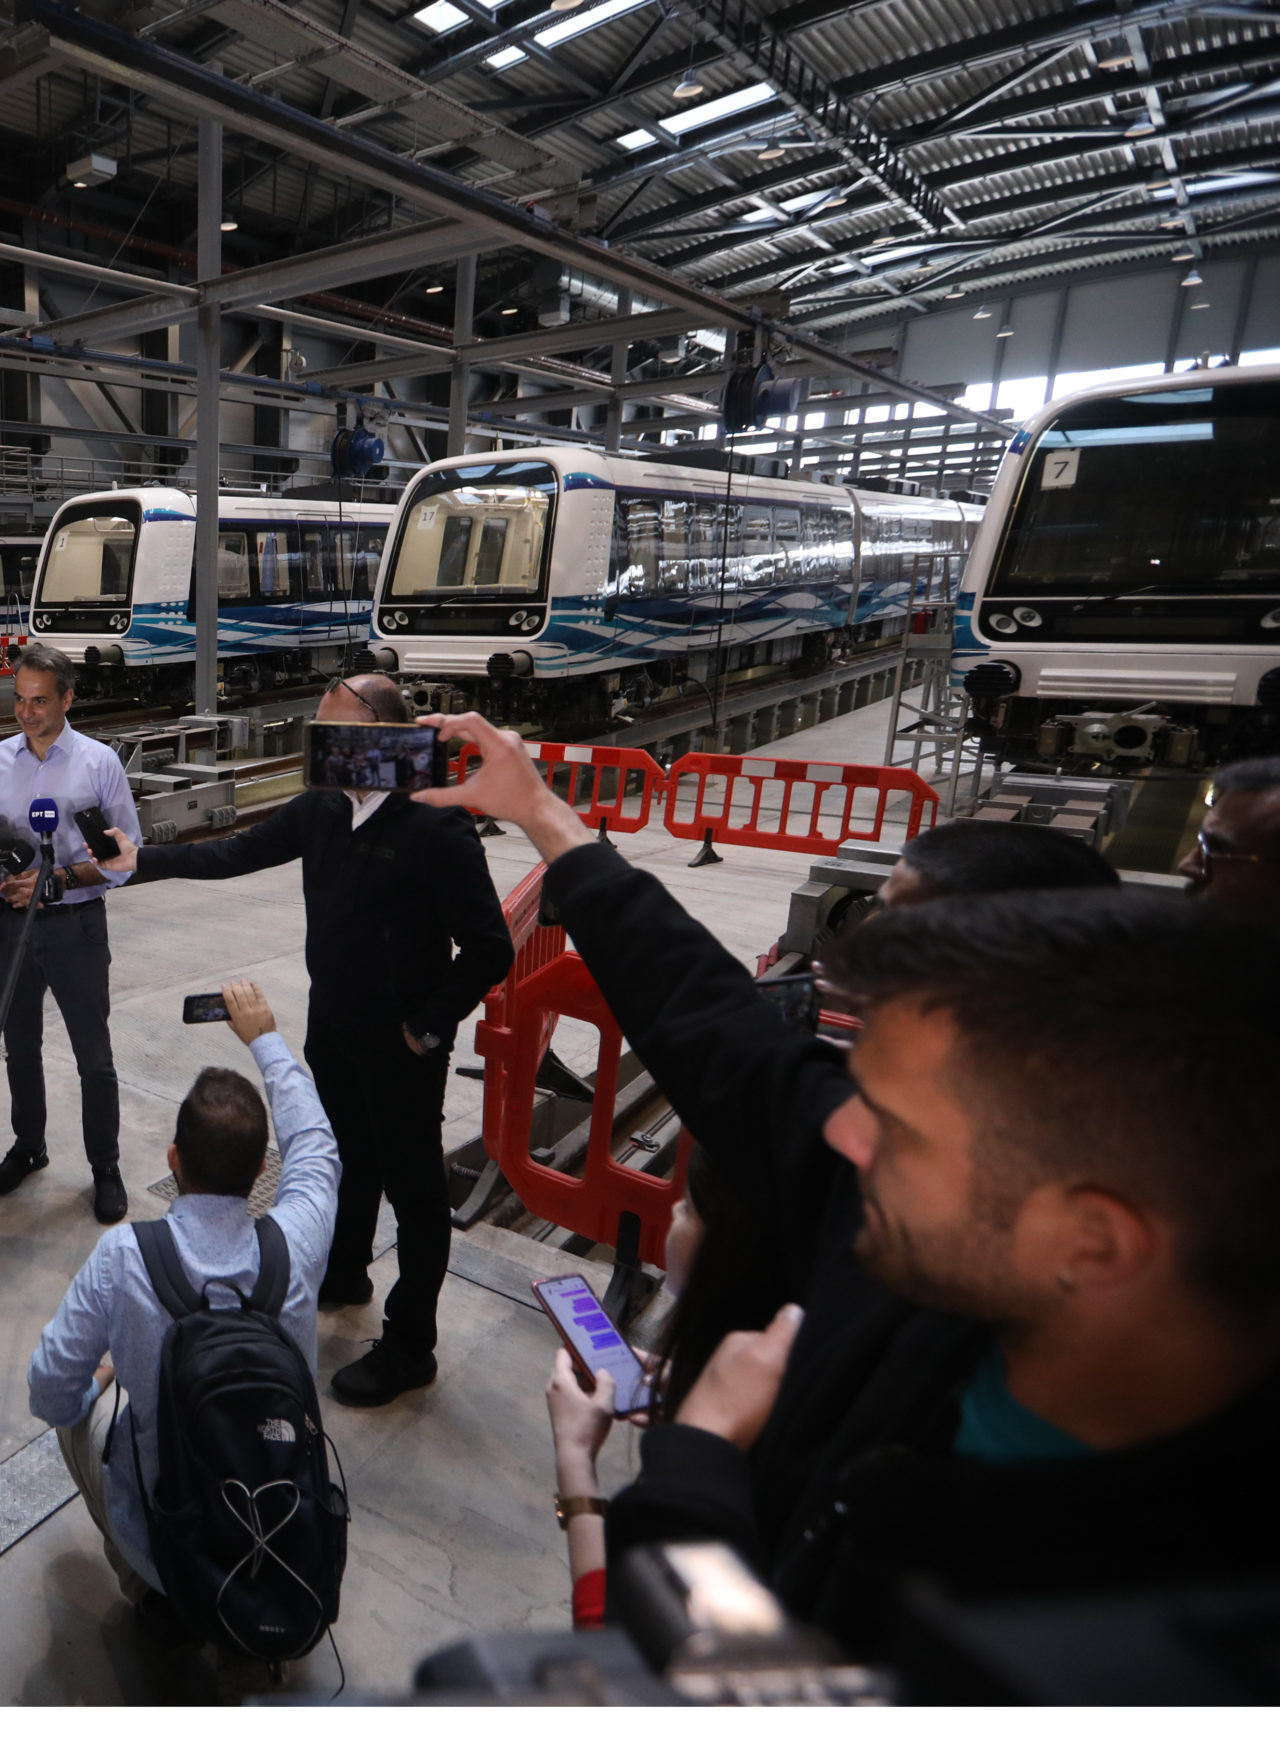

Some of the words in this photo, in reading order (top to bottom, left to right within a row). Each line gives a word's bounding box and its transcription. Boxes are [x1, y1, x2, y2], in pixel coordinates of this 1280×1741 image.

[1054, 461, 1069, 479] 7
[422, 511, 435, 521] 17
[265, 1418, 281, 1426] THE
[257, 1424, 281, 1435] NORTH
[263, 1433, 281, 1441] FACE
